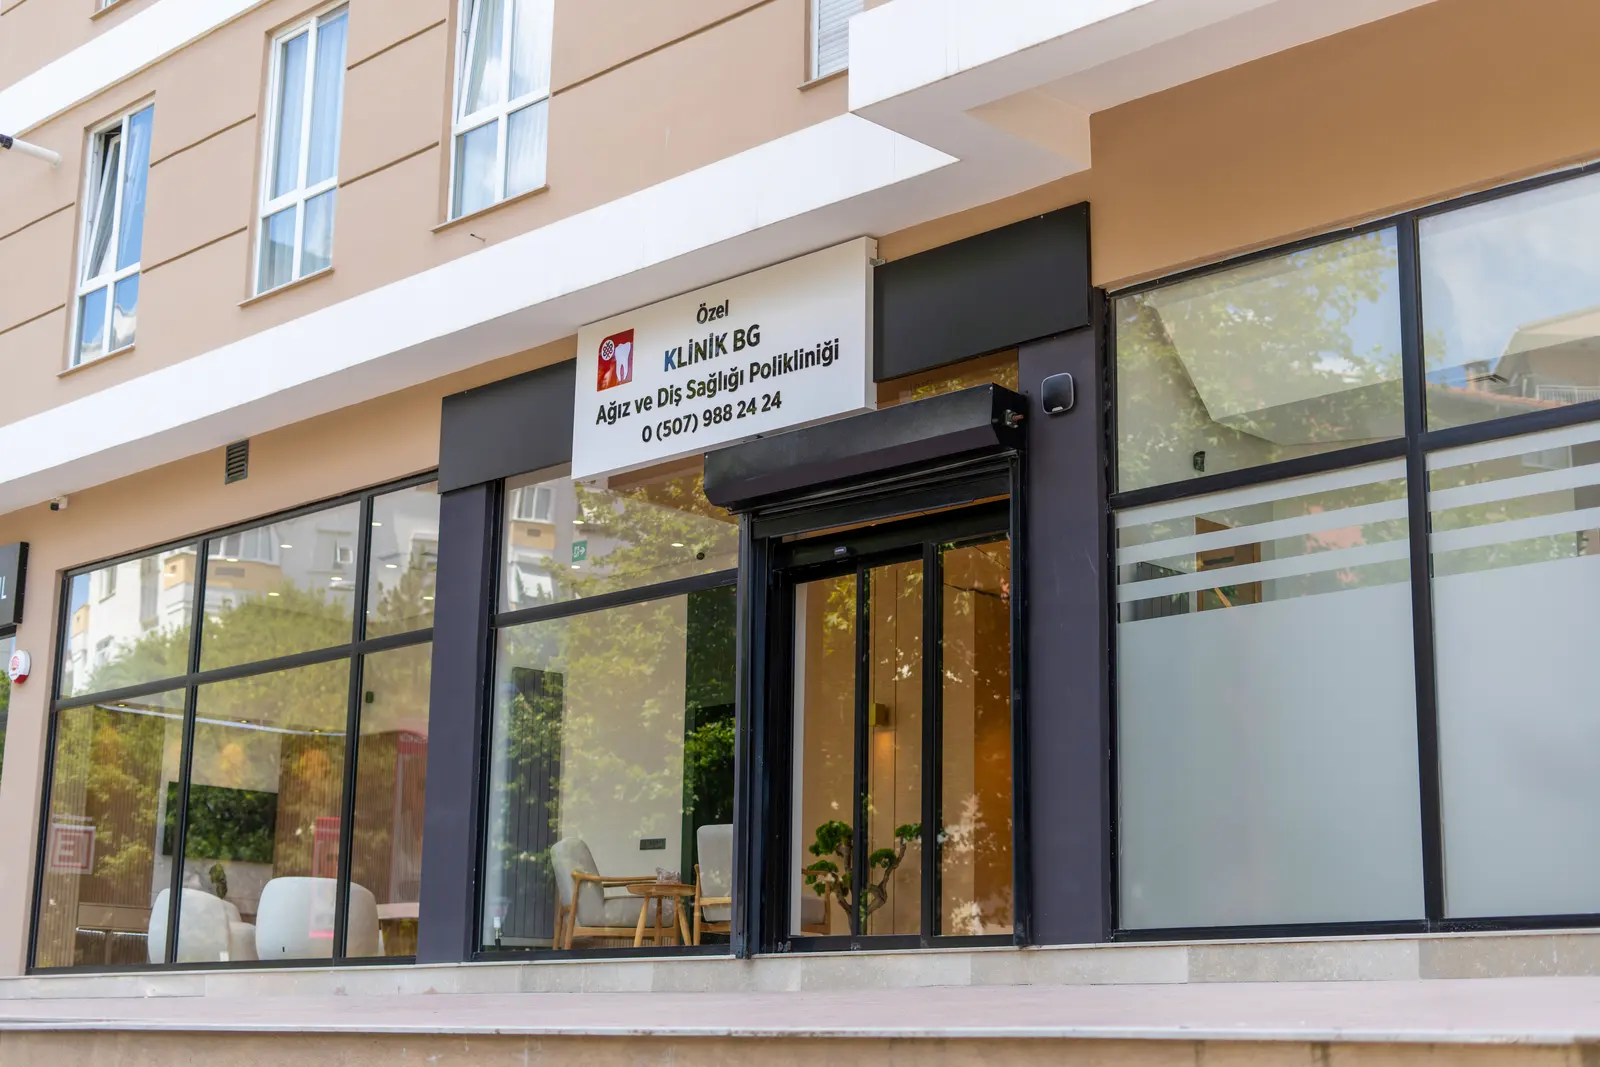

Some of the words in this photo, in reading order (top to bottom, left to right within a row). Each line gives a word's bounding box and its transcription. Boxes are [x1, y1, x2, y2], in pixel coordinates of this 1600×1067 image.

[696, 299, 730, 325] Özel
[664, 332, 729, 372] KLİNİK
[732, 323, 761, 353] BG
[595, 401, 631, 426] Ağız
[634, 396, 653, 414] ve
[657, 386, 683, 408] Diş
[685, 366, 745, 400] Sağlığı
[749, 337, 840, 384] Polikliniği
[641, 424, 653, 443] 0
[656, 412, 699, 442] (507)
[702, 405, 733, 428] 988
[736, 396, 758, 420] 24
[760, 390, 783, 412] 24
